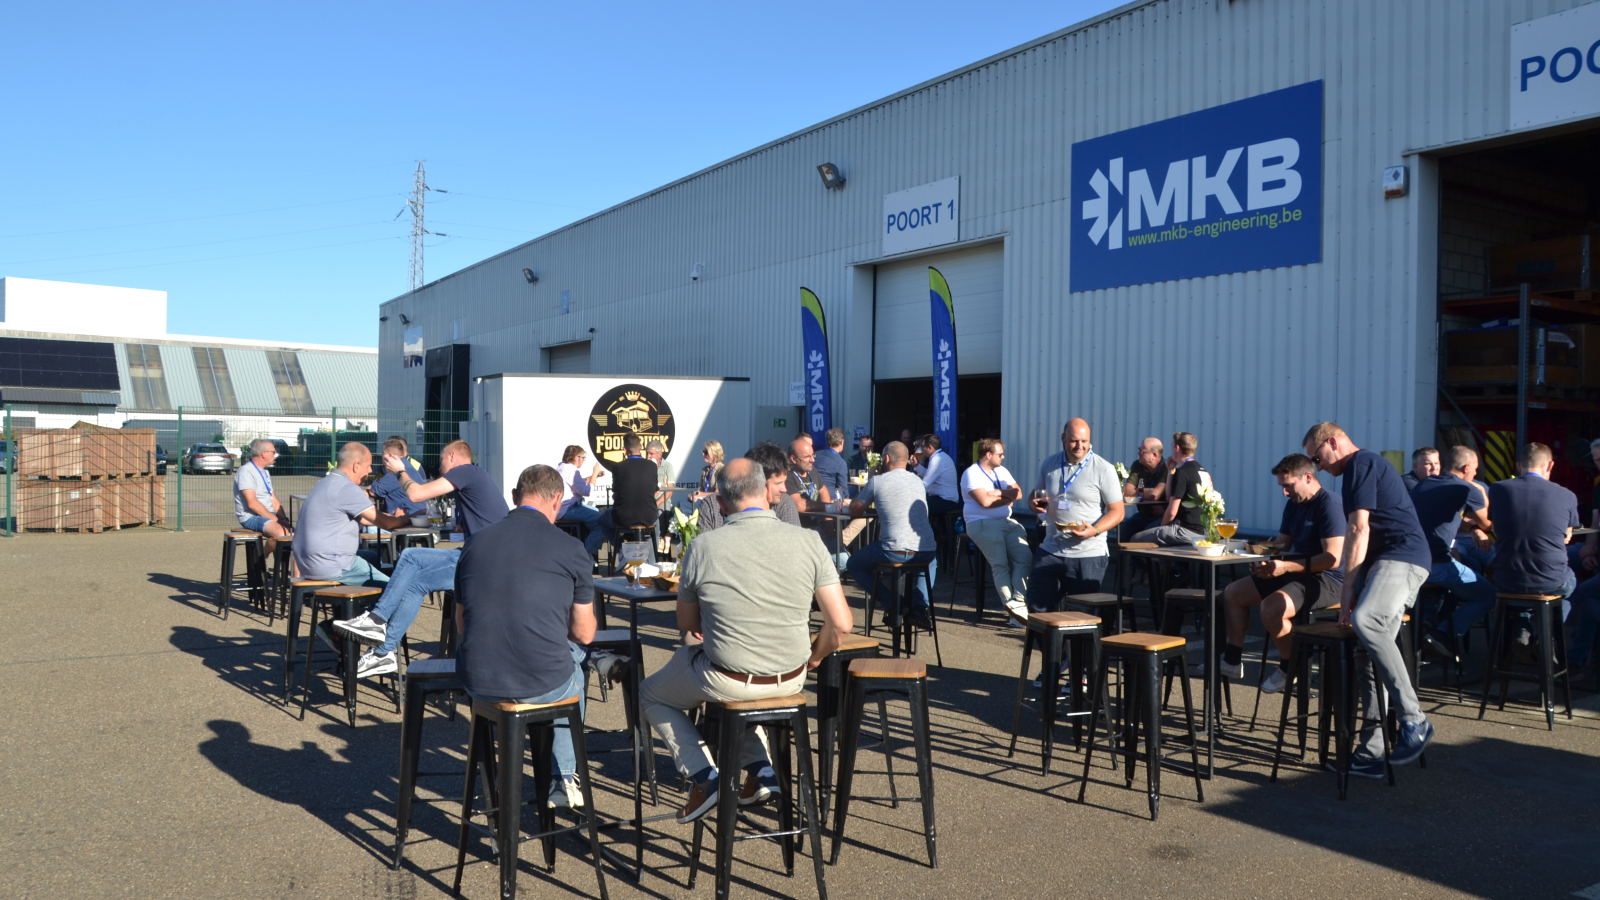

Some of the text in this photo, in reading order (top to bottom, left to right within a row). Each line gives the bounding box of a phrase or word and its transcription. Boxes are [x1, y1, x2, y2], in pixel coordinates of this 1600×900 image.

[1128, 137, 1302, 231] MKB
[887, 199, 954, 234] POORT 1
[1128, 207, 1302, 247] www.mkb-engineering.be
[811, 369, 824, 432] MKB
[940, 360, 950, 432] MKB
